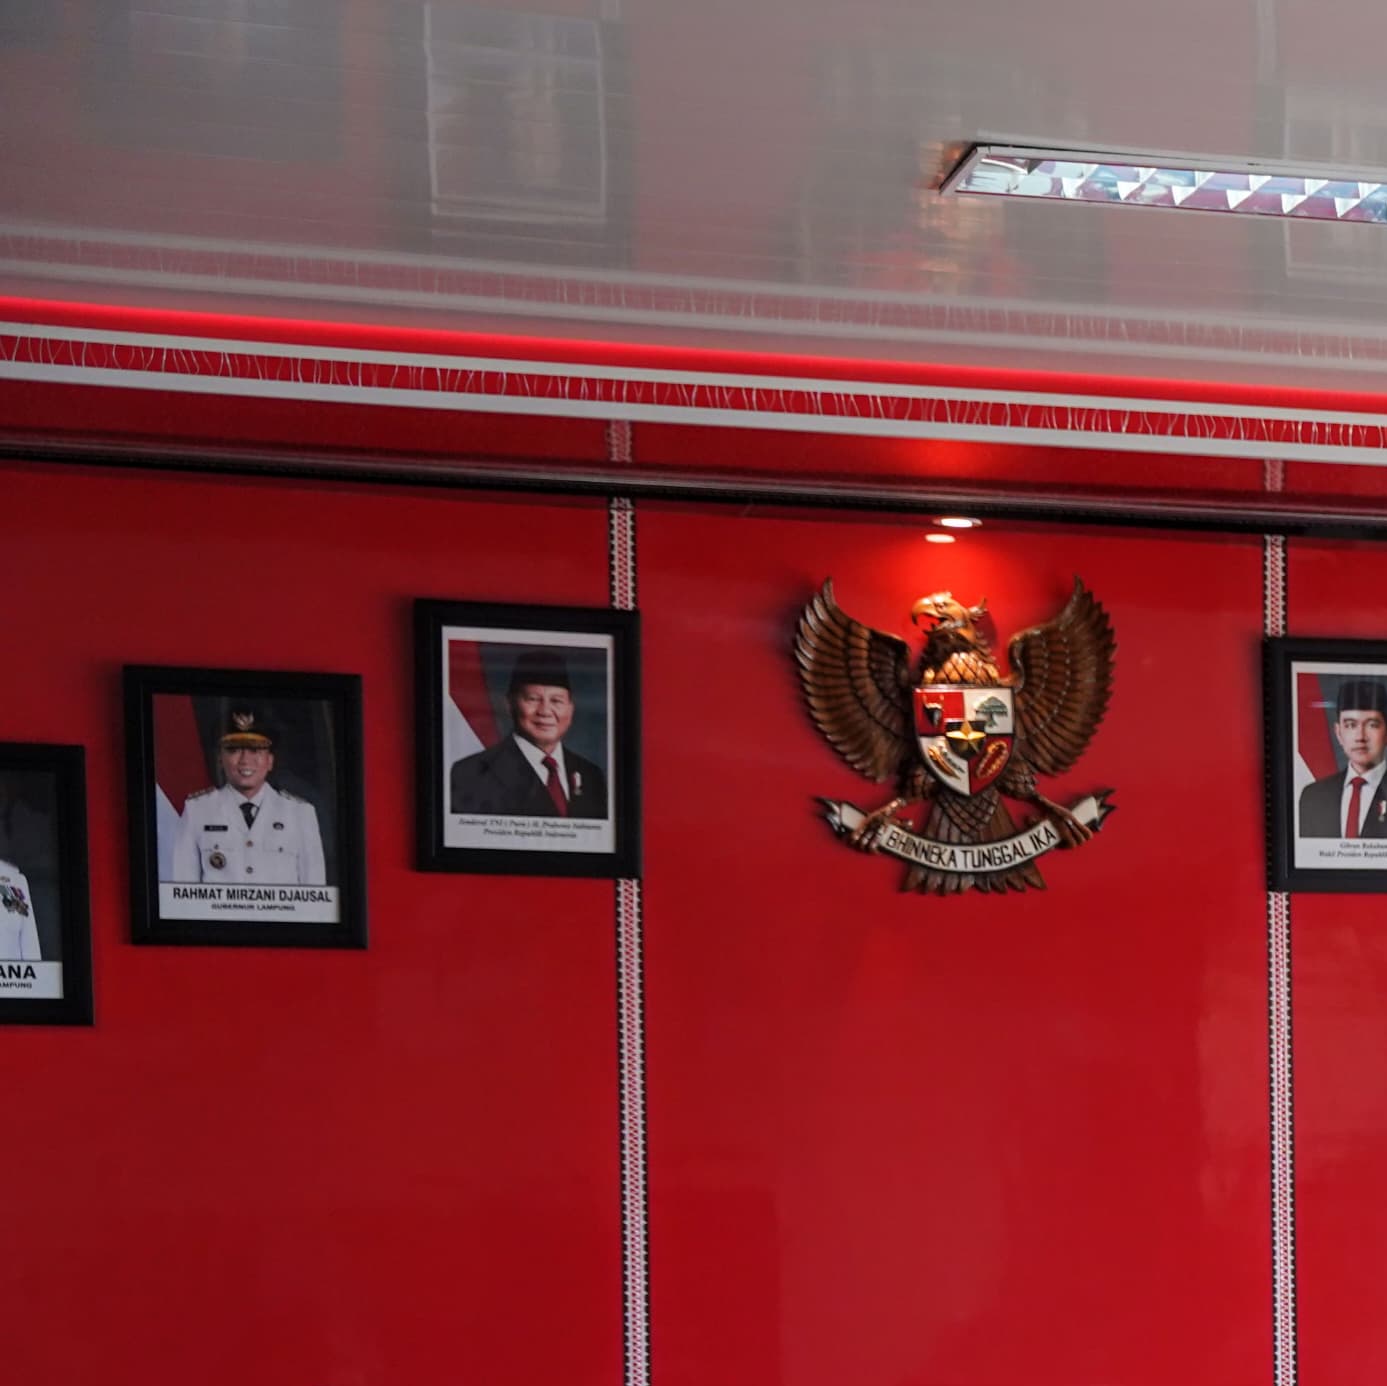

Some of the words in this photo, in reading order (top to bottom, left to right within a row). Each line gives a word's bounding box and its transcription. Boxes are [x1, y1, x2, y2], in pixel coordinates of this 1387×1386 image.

[886, 831, 957, 869] BHINNEKA
[960, 842, 1028, 870] TUNGGAL
[1031, 826, 1057, 851] IKA
[173, 887, 224, 900] RAHMAT
[226, 888, 276, 902] MIRZANI
[279, 890, 333, 903] DJAUSAL
[257, 904, 296, 912] LAMPUNG
